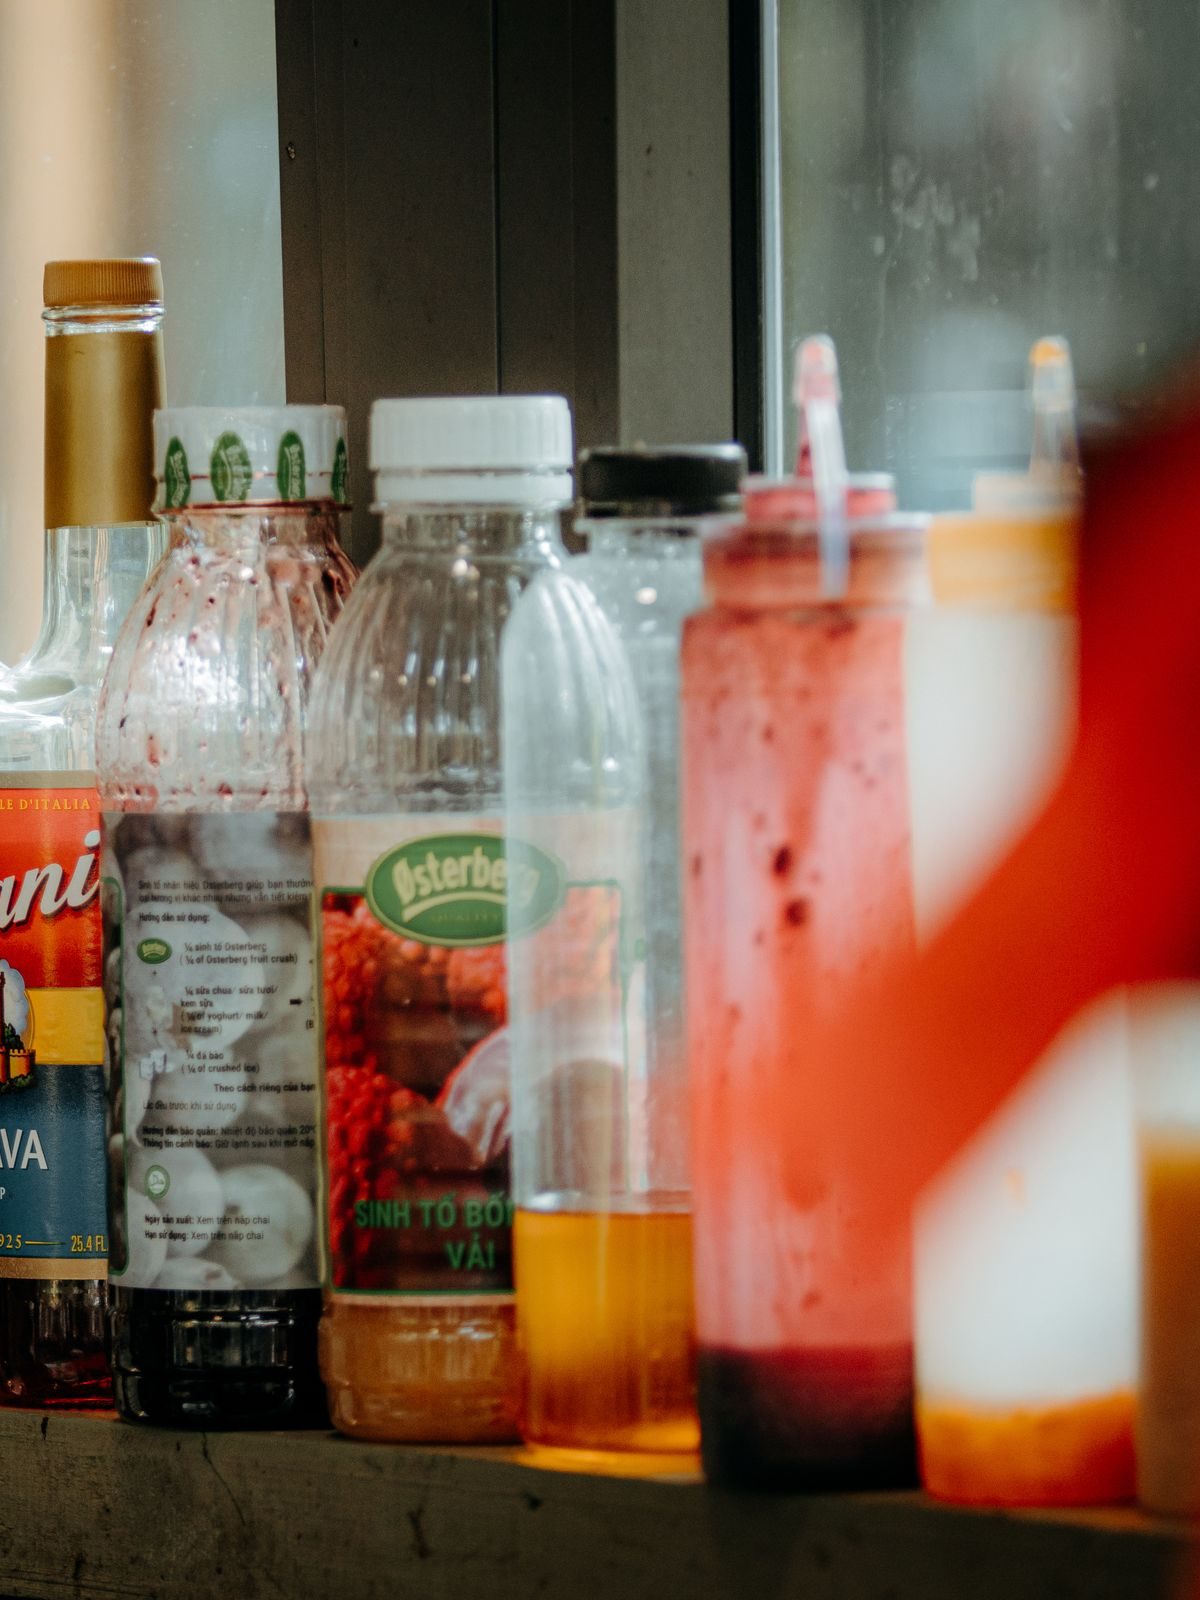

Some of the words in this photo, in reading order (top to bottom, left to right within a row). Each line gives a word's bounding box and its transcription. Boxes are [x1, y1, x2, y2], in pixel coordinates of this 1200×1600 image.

[19, 798, 91, 810] D'ITALIA
[195, 955, 205, 964] of
[250, 954, 268, 964] fruit
[271, 953, 298, 965] crush)
[180, 999, 196, 1007] kem
[207, 1011, 242, 1021] yoghurt/
[246, 1011, 269, 1020] milk/
[197, 1064, 206, 1073] of
[208, 1063, 241, 1073] crushed
[244, 1063, 260, 1074] ice)
[214, 1083, 234, 1092] Theo
[216, 1100, 237, 1112] dụng
[355, 1200, 411, 1229] SINH
[418, 1190, 457, 1229] TỐ
[197, 1215, 214, 1225] Xem
[252, 1214, 271, 1225] chai
[191, 1231, 209, 1240] Xem
[246, 1230, 265, 1240] chai
[71, 1235, 92, 1252] 25.4
[445, 1230, 496, 1270] VẢI
